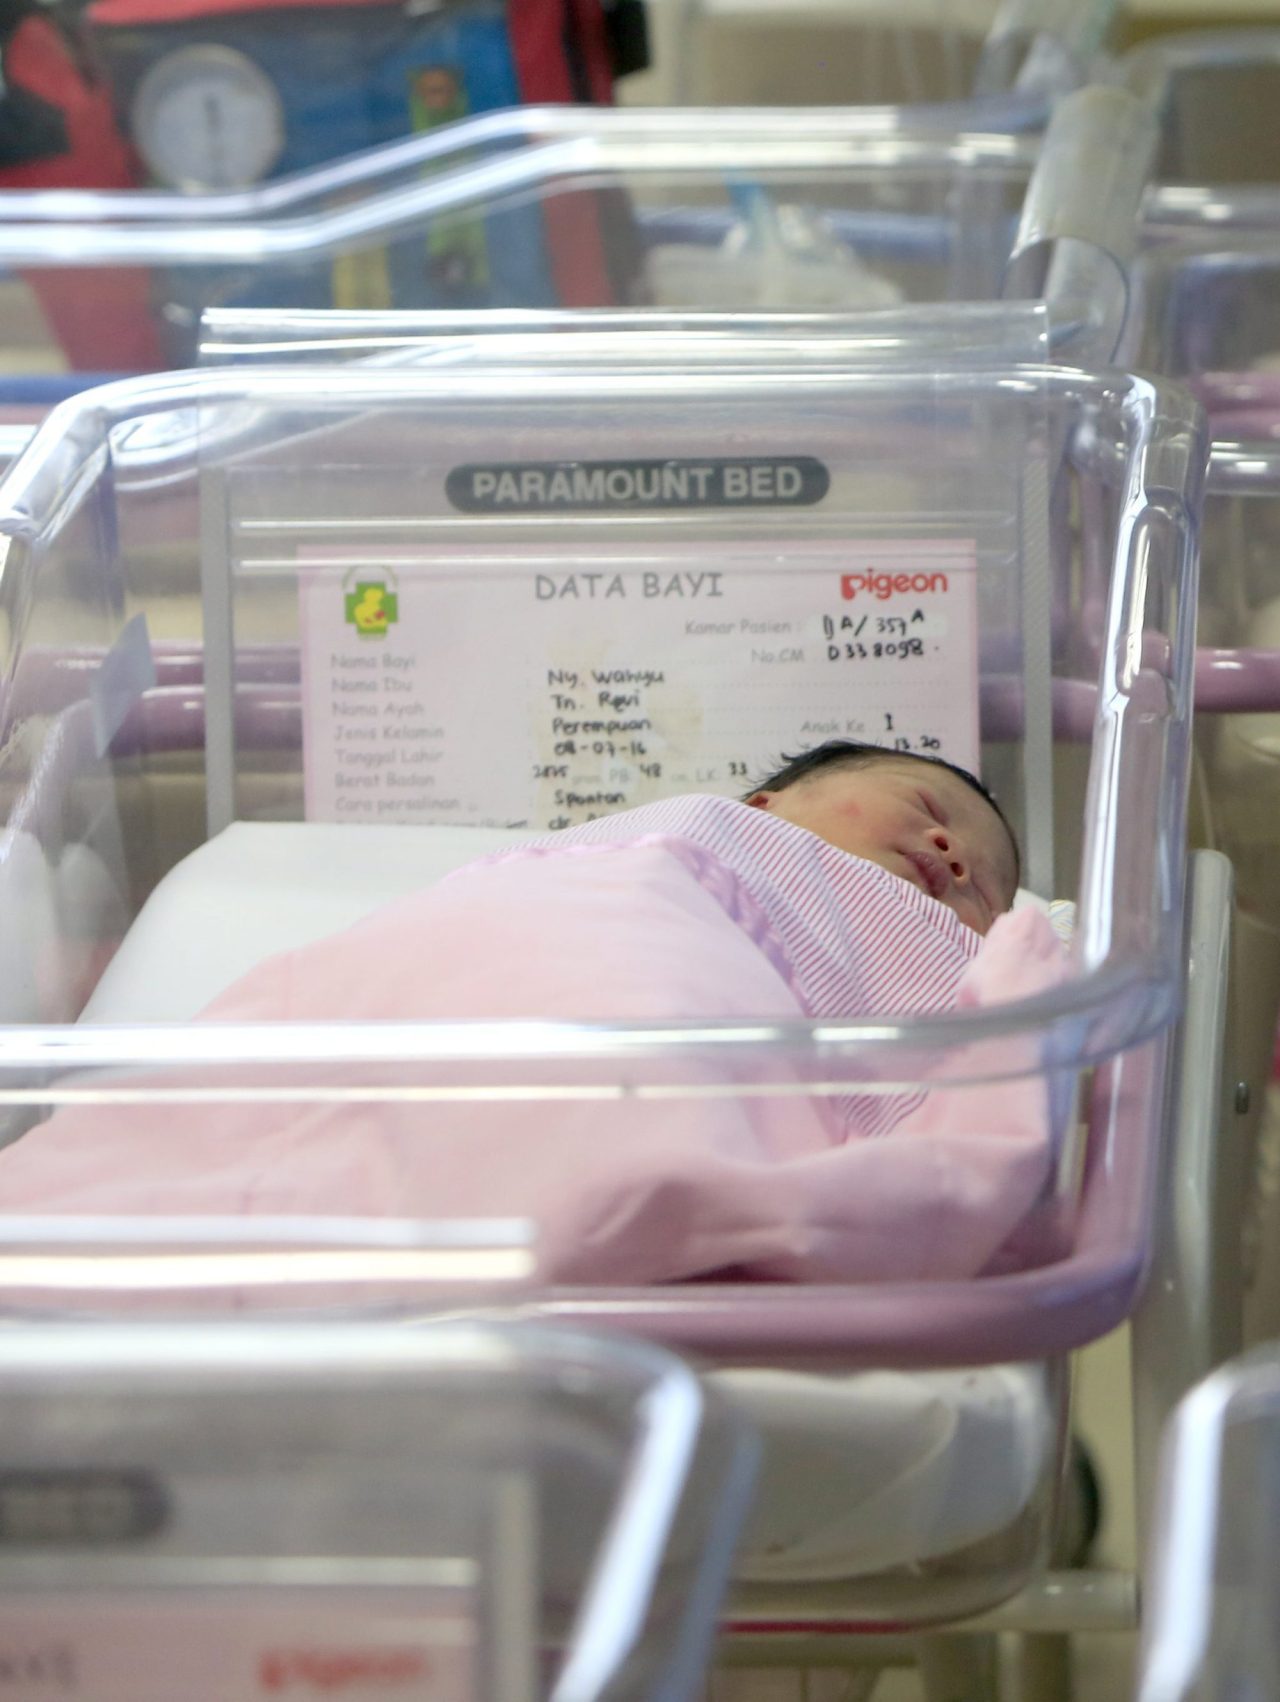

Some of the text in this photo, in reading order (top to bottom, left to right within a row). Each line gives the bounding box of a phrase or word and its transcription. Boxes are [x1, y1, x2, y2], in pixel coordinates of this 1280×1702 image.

[472, 465, 803, 503] PARAMOUNT BED
[535, 571, 724, 601] DATA BAYI
[840, 568, 948, 601] pigeon
[684, 618, 792, 635] Kamar Pasien
[331, 652, 416, 671] Nama Bayi
[331, 676, 413, 692] Nama Ibu
[332, 701, 425, 718] Nama Ayah
[382, 724, 445, 740] Kelamin
[799, 718, 866, 734] Anak Ke
[334, 748, 445, 767] Tanggal Lahir
[334, 770, 435, 787] Berat Badan
